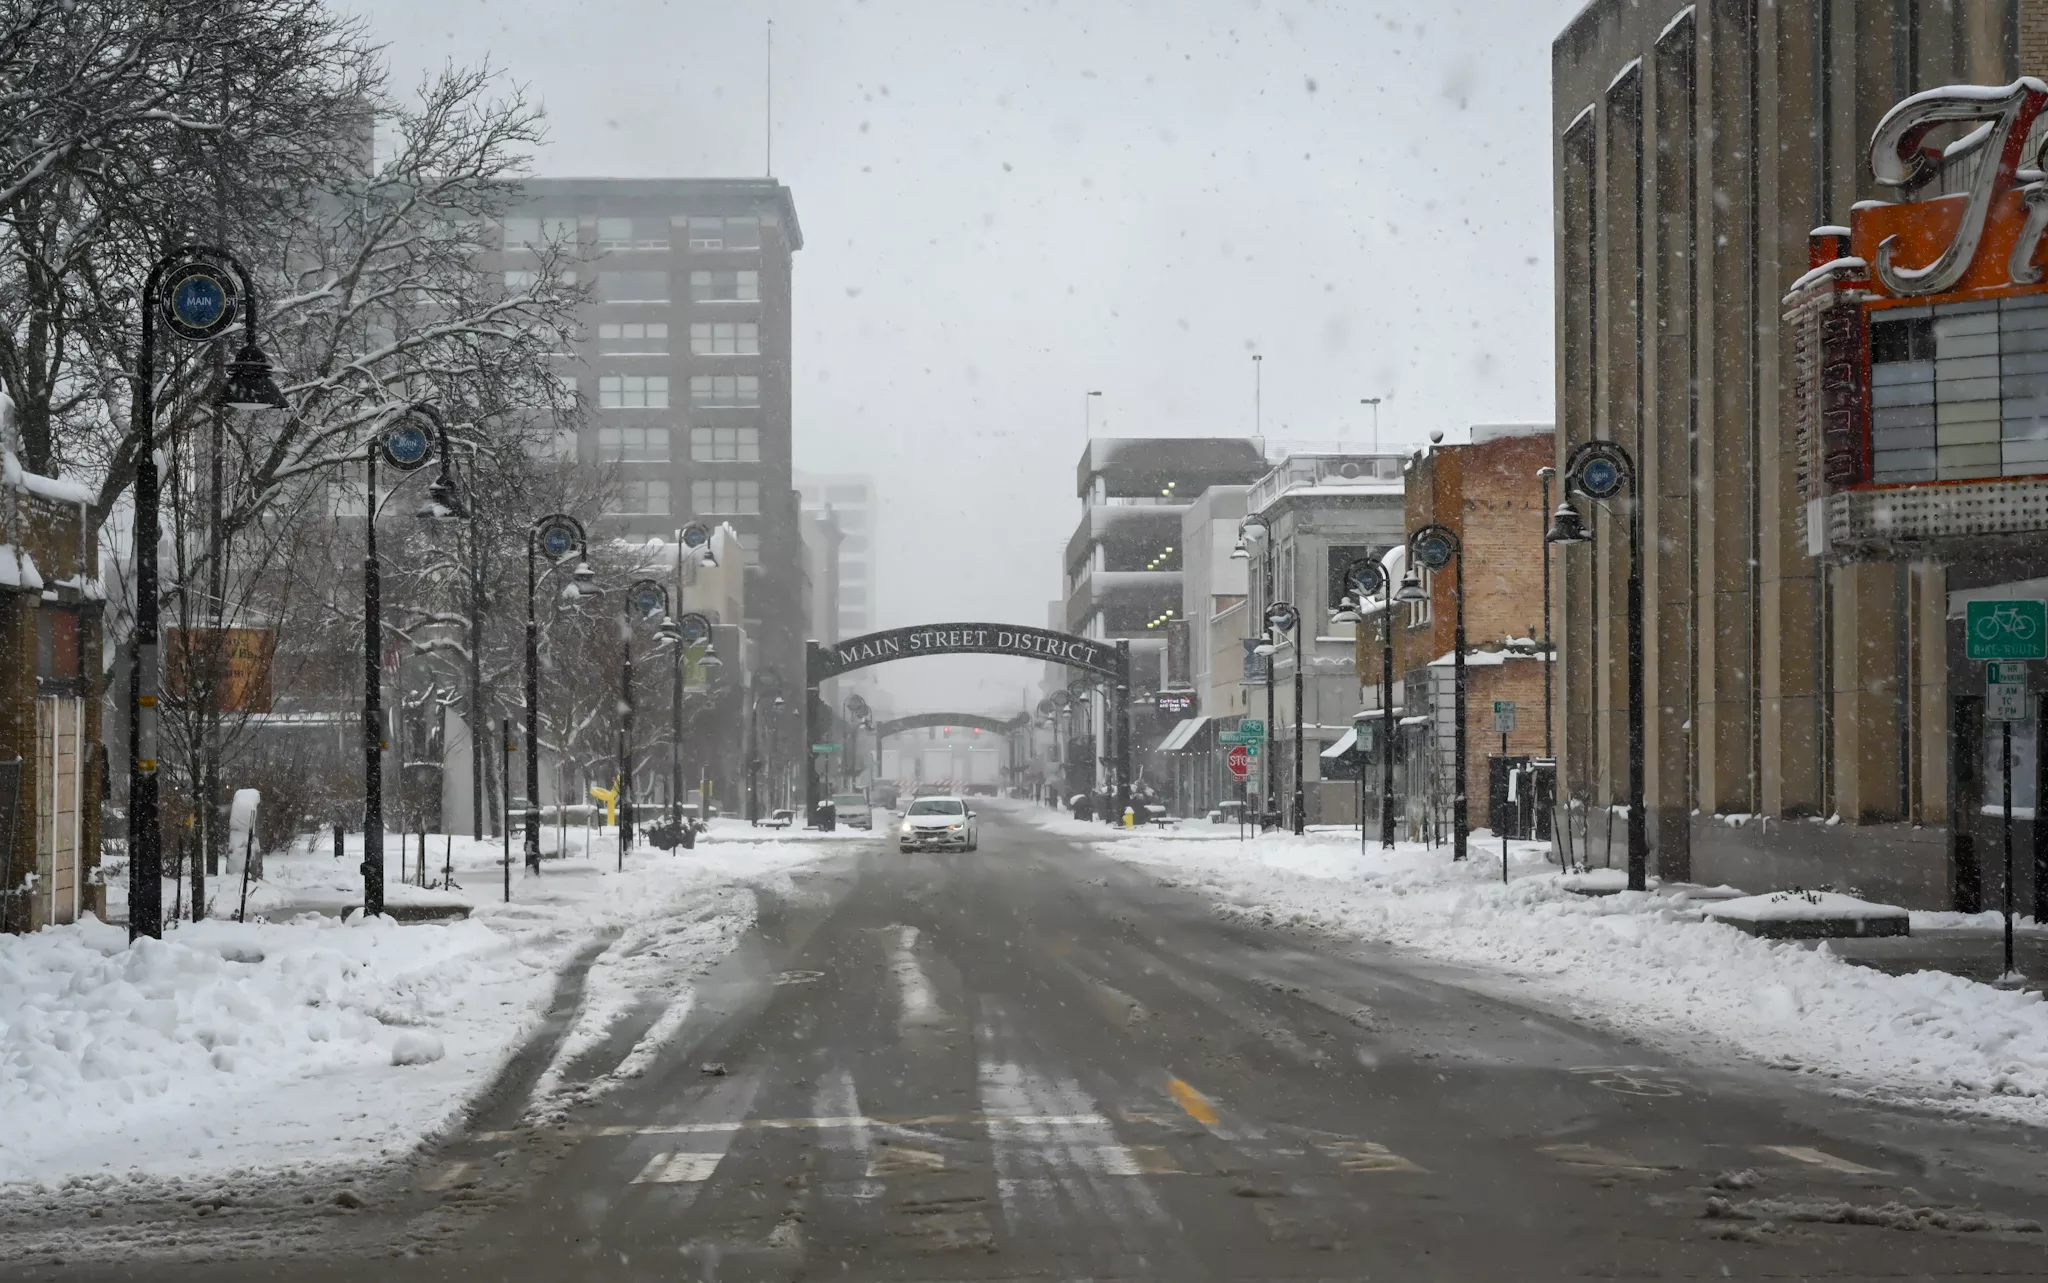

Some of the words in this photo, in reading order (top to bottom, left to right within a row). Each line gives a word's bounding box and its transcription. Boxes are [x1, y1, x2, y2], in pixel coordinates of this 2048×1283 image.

[163, 297, 170, 305] N
[186, 296, 212, 306] MAIN
[225, 297, 236, 306] ST
[399, 439, 417, 447] MAIN
[838, 637, 900, 665] MAIN
[910, 630, 987, 649] STREET
[998, 631, 1097, 664] DISTRICT
[1973, 644, 1999, 656] BIKE
[2004, 644, 2041, 656] ROUTE
[1991, 666, 1996, 681] 1
[2006, 687, 2017, 695] AM
[2005, 707, 2017, 715] PM
[1229, 755, 1247, 766] STO
